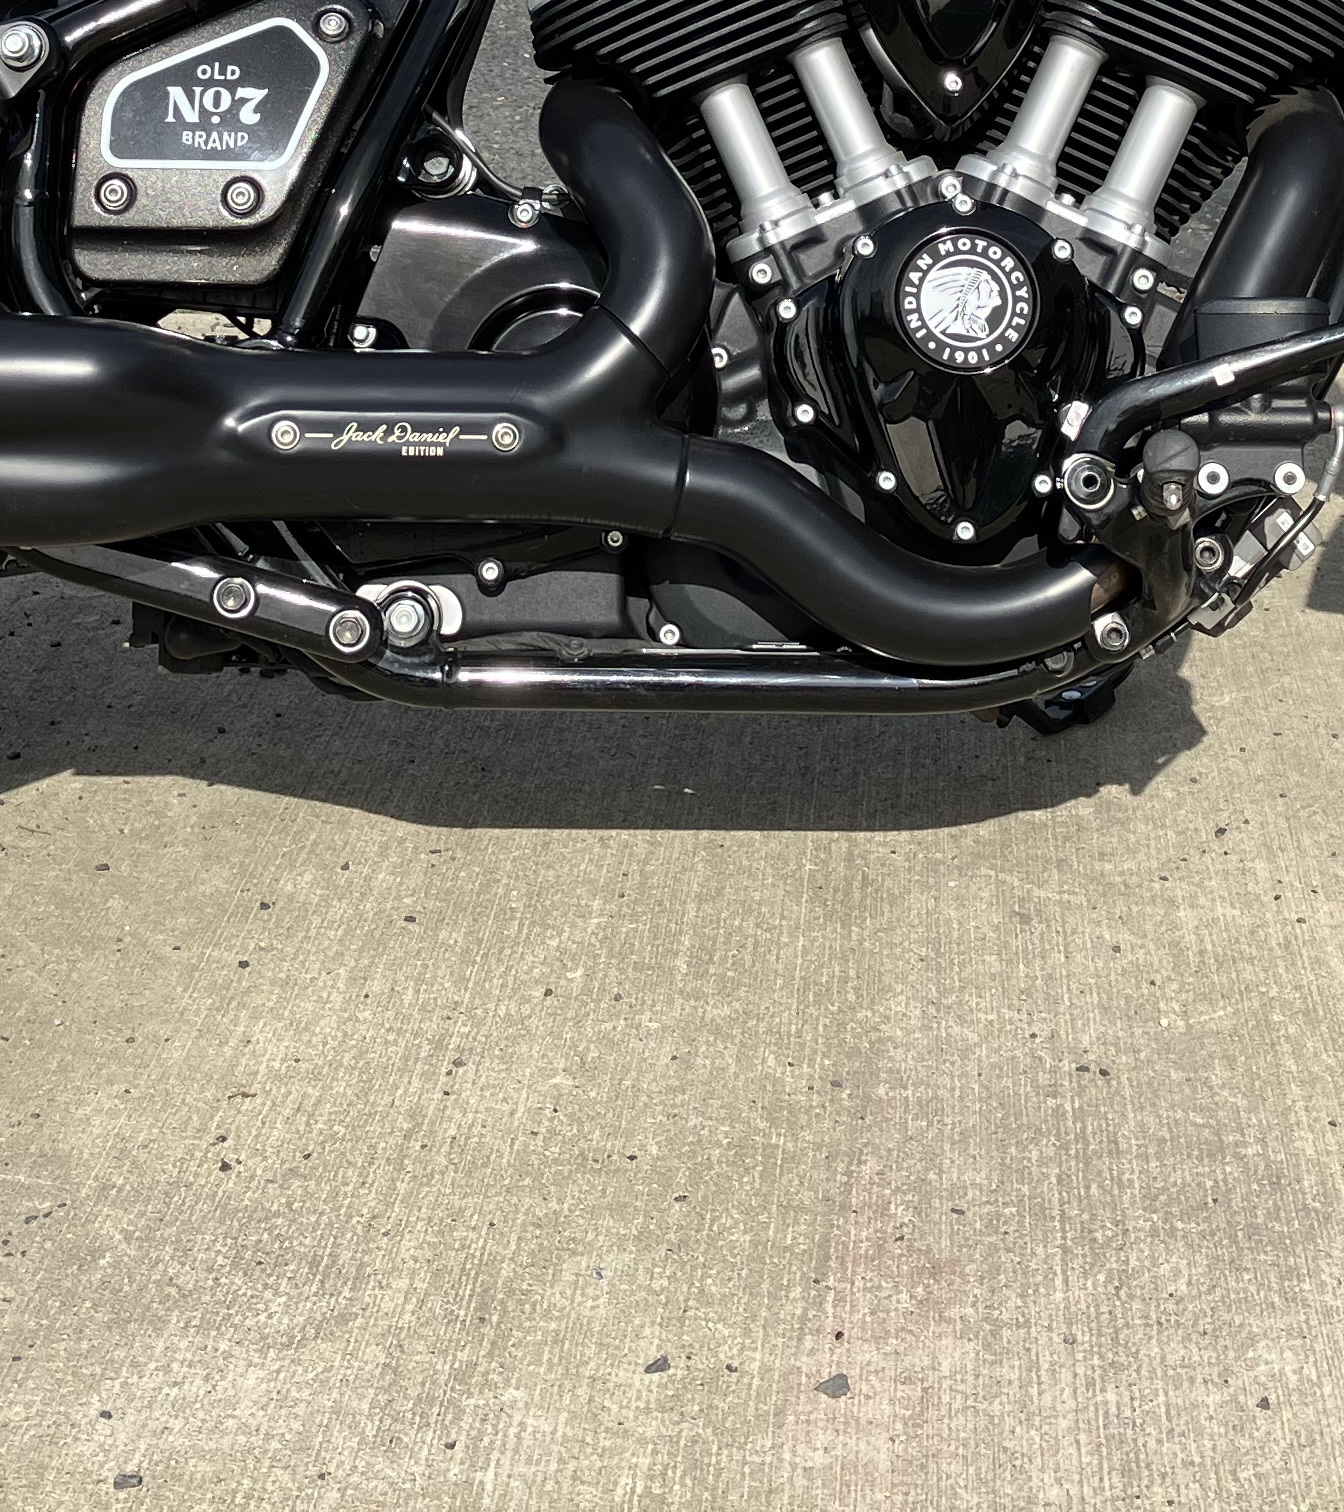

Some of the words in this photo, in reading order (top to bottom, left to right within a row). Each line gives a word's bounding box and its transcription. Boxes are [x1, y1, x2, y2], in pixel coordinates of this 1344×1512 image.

[197, 61, 240, 80] OLD
[182, 130, 249, 150] BRAND
[904, 253, 934, 339] INDIAN
[937, 237, 1029, 343] MOTORCYCLE
[942, 347, 990, 363] 1901
[331, 422, 388, 450] Jack
[387, 421, 461, 447] Daniel
[401, 446, 444, 456] EDITION
